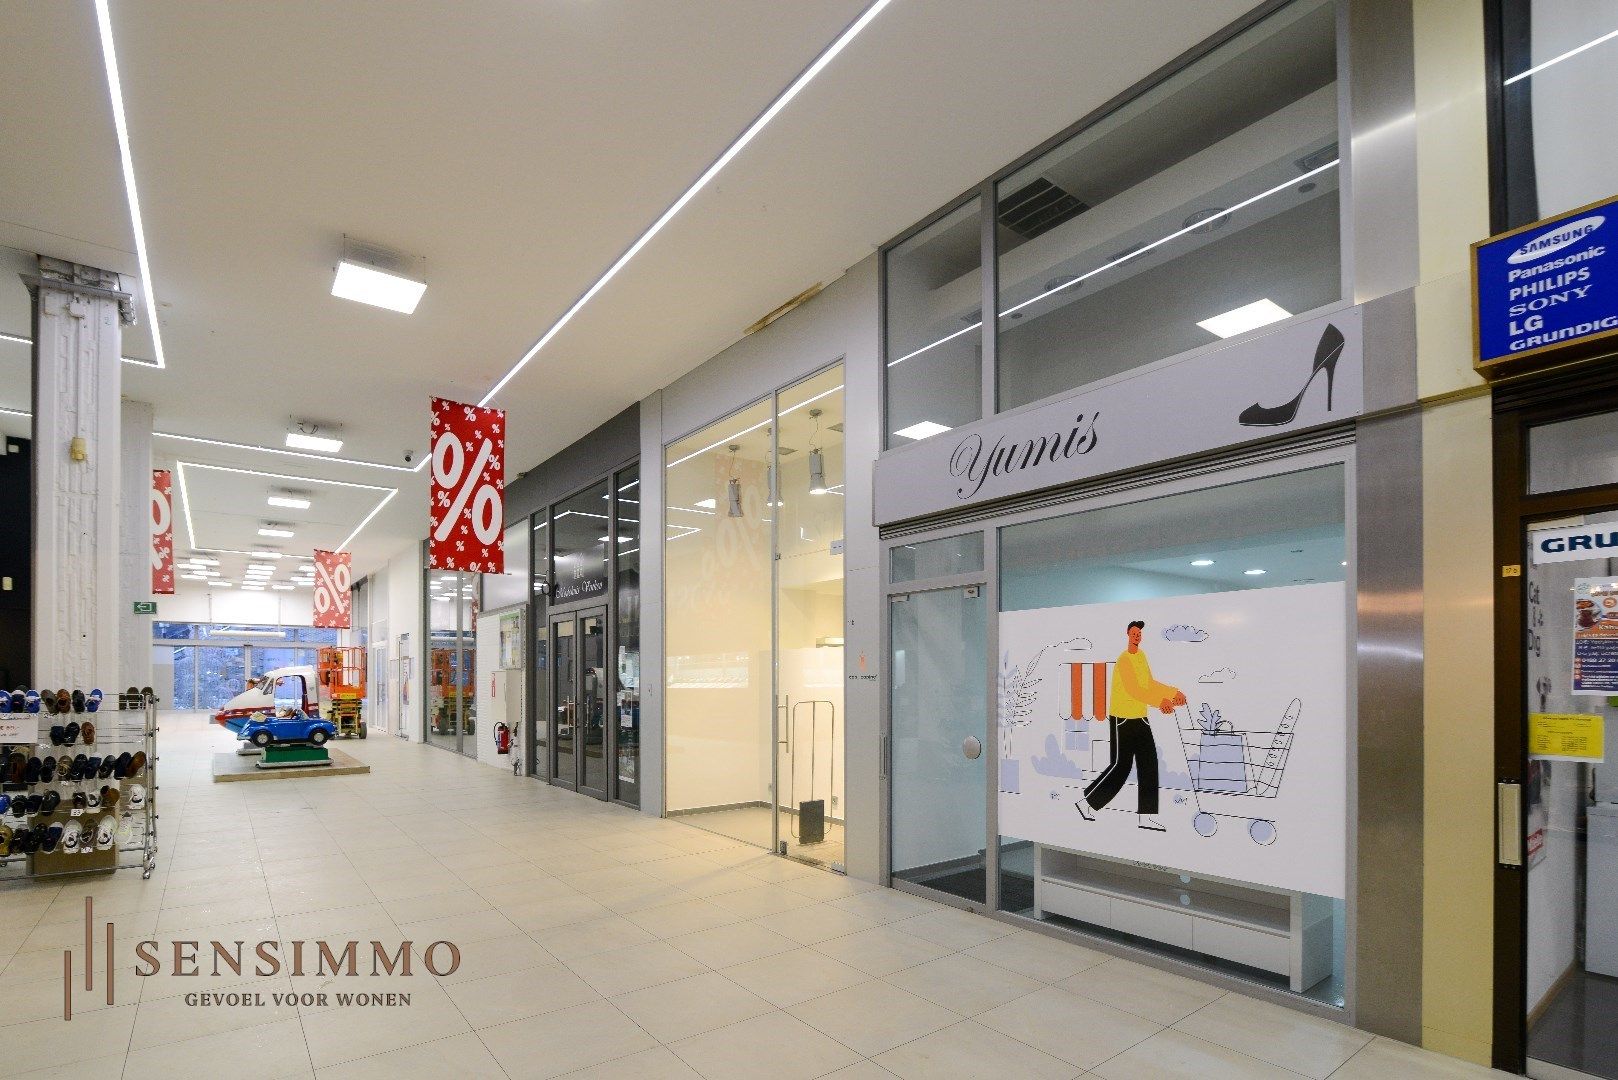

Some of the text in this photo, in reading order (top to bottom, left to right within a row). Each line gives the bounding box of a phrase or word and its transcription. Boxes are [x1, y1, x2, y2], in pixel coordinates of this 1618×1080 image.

[1520, 224, 1593, 255] SAMSUNG
[1508, 245, 1606, 283] Panasonic
[1509, 266, 1591, 301] PHILIPS
[1509, 284, 1593, 317] SONY
[1509, 314, 1544, 336] LG
[1509, 315, 1618, 351] GRUNDIG
